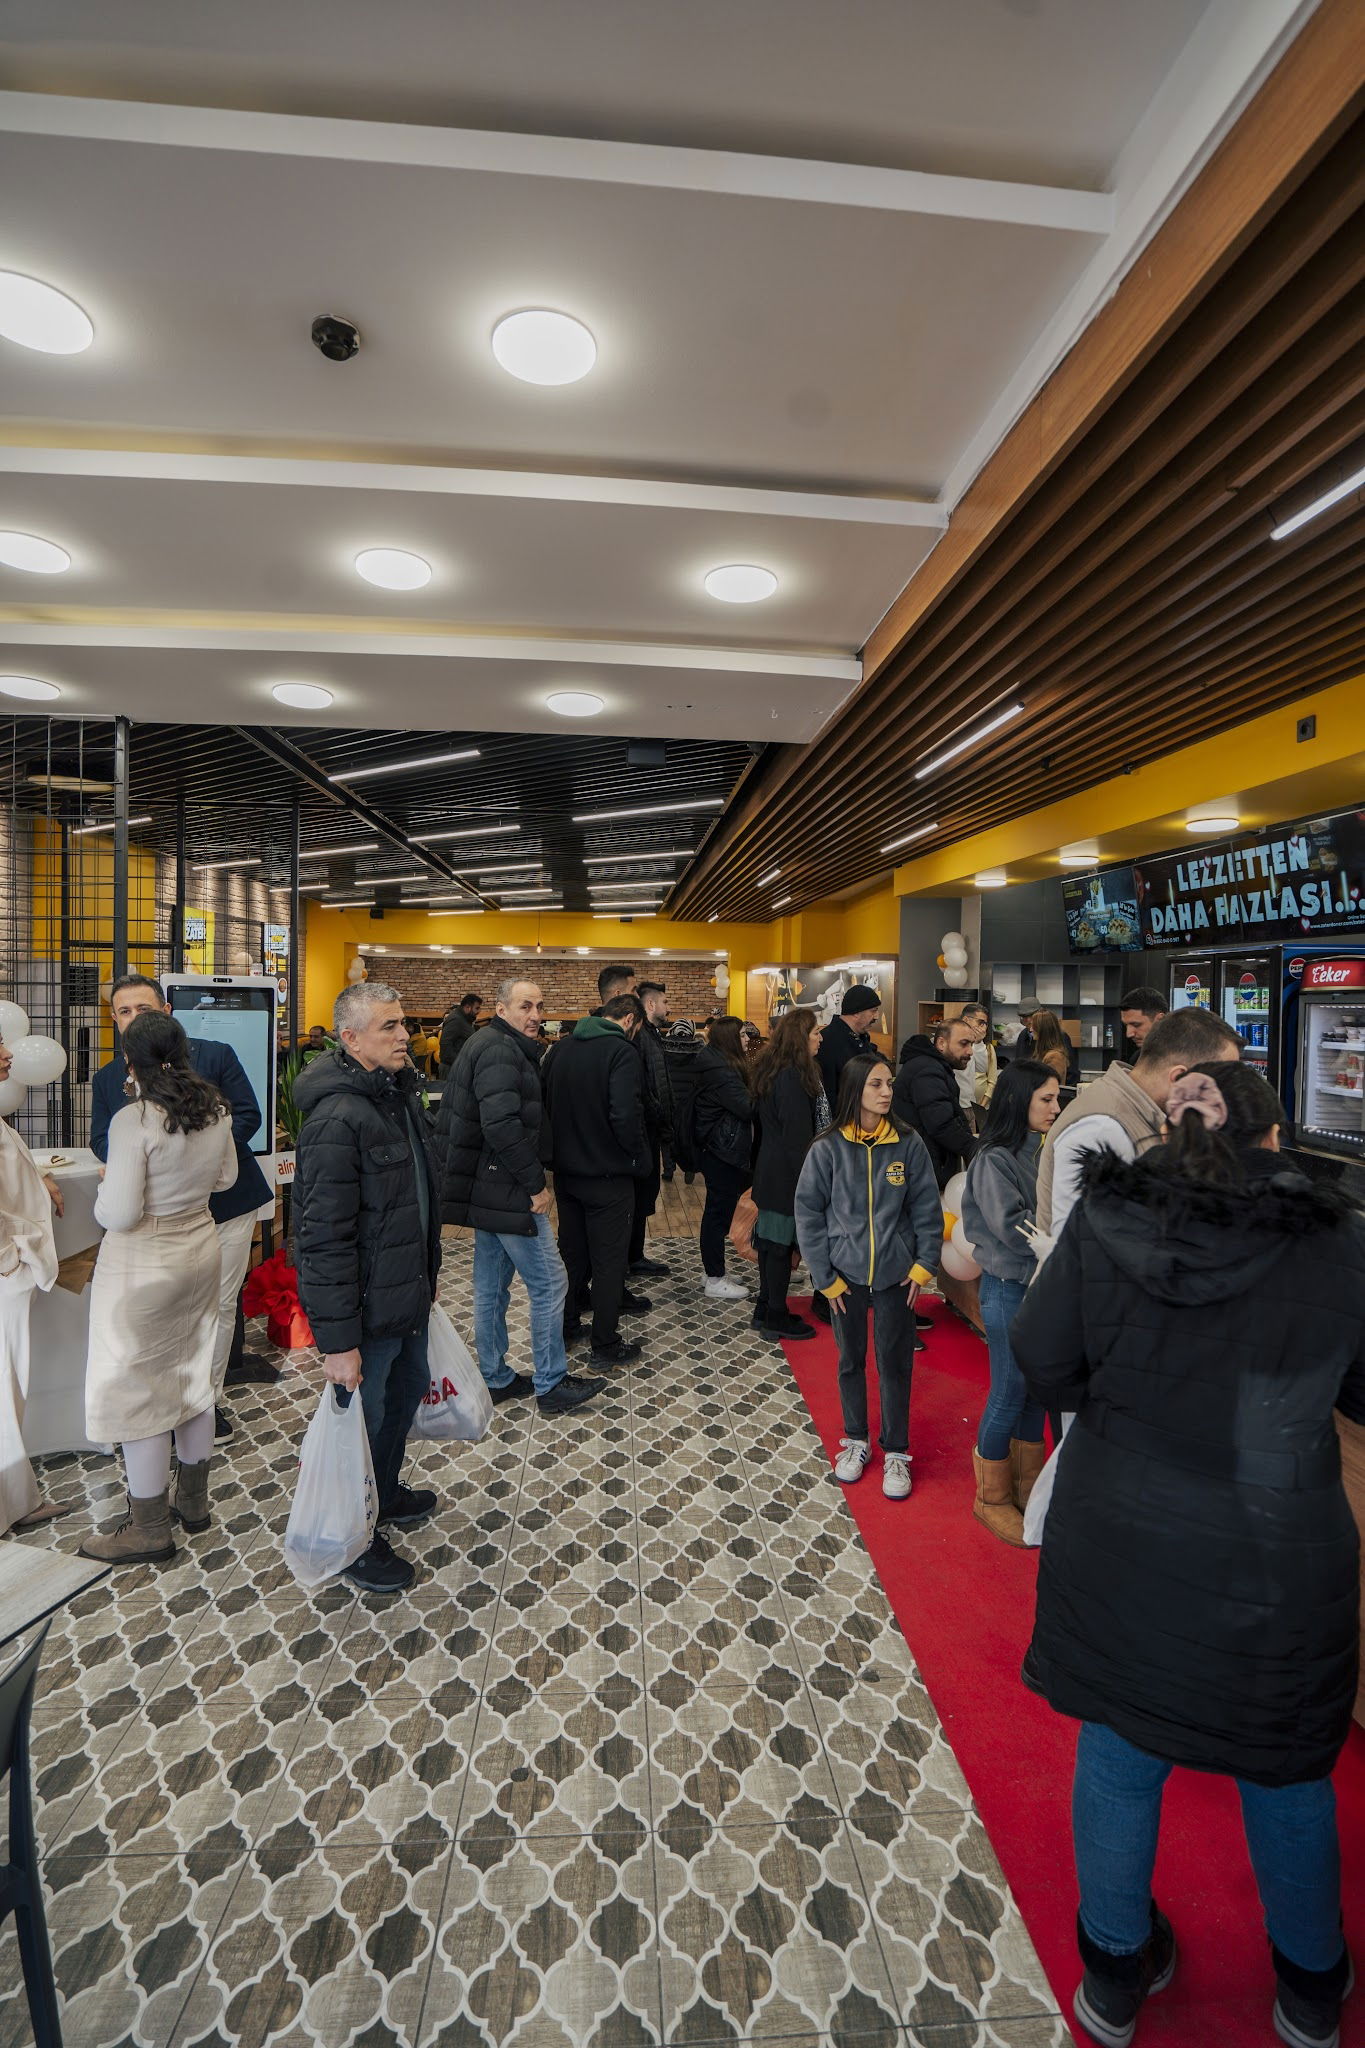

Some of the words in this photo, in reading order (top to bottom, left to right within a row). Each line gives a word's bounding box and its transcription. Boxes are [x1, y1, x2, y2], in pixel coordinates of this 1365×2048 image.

[1177, 837, 1310, 892] LEZZETTEN
[1151, 900, 1210, 933] DAHA
[1312, 965, 1350, 983] Eker
